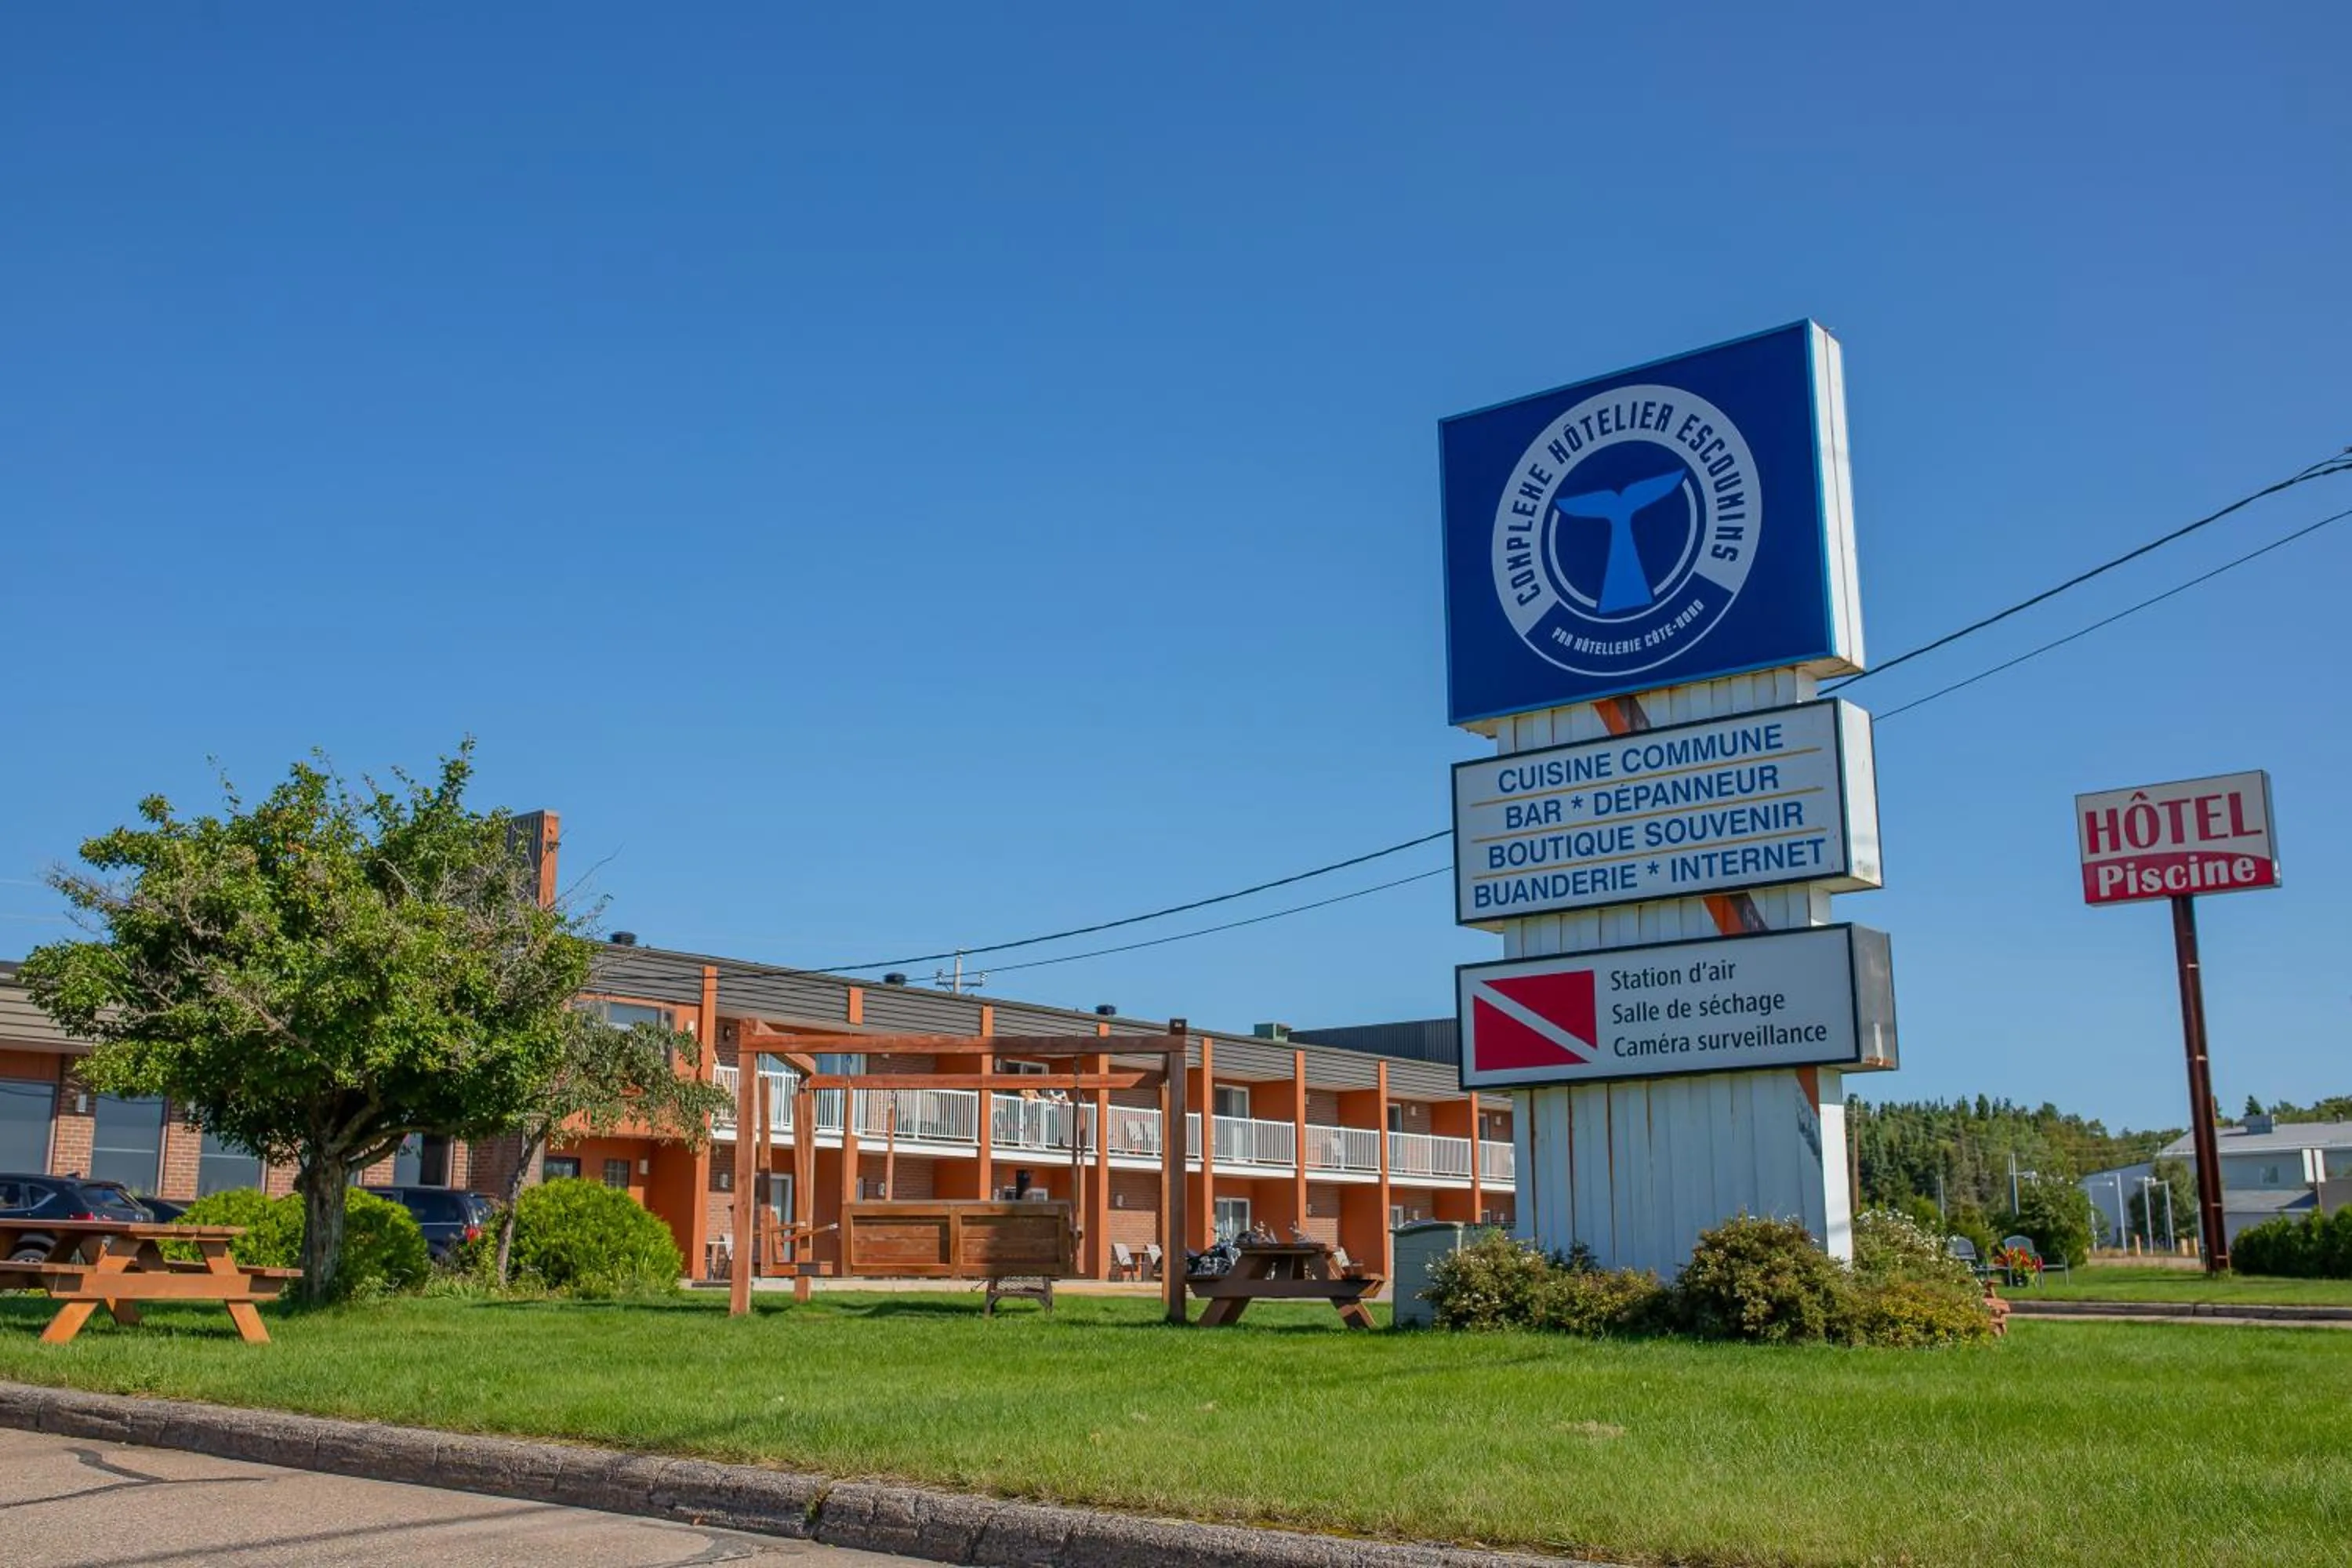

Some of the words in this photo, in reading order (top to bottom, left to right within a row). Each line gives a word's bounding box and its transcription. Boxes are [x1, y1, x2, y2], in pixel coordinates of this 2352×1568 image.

[1548, 401, 1674, 465] HÔTELIER
[1675, 413, 1746, 562] ESCOUMINS
[1498, 753, 1612, 794] CUISINE
[1621, 724, 1784, 773] COMMUNE
[1505, 799, 1563, 830] BAR
[1594, 764, 1780, 817] DÉPANNEUR
[2085, 790, 2263, 855] HÔTEL
[1489, 826, 1636, 869] BOUTIQUE
[1645, 800, 1804, 848] SOUVENIR
[1474, 863, 1639, 909] BUANDERIE
[1671, 838, 1826, 883] INTERNET
[2097, 855, 2257, 898] Piscine
[1610, 966, 1682, 991] Station
[1689, 959, 1737, 984] d'air
[1612, 1001, 1661, 1025] Salle
[1667, 998, 1692, 1020] de
[1699, 991, 1786, 1016] séchage
[1613, 1032, 1690, 1058] Caméra
[1697, 1023, 1828, 1051] surveillance
